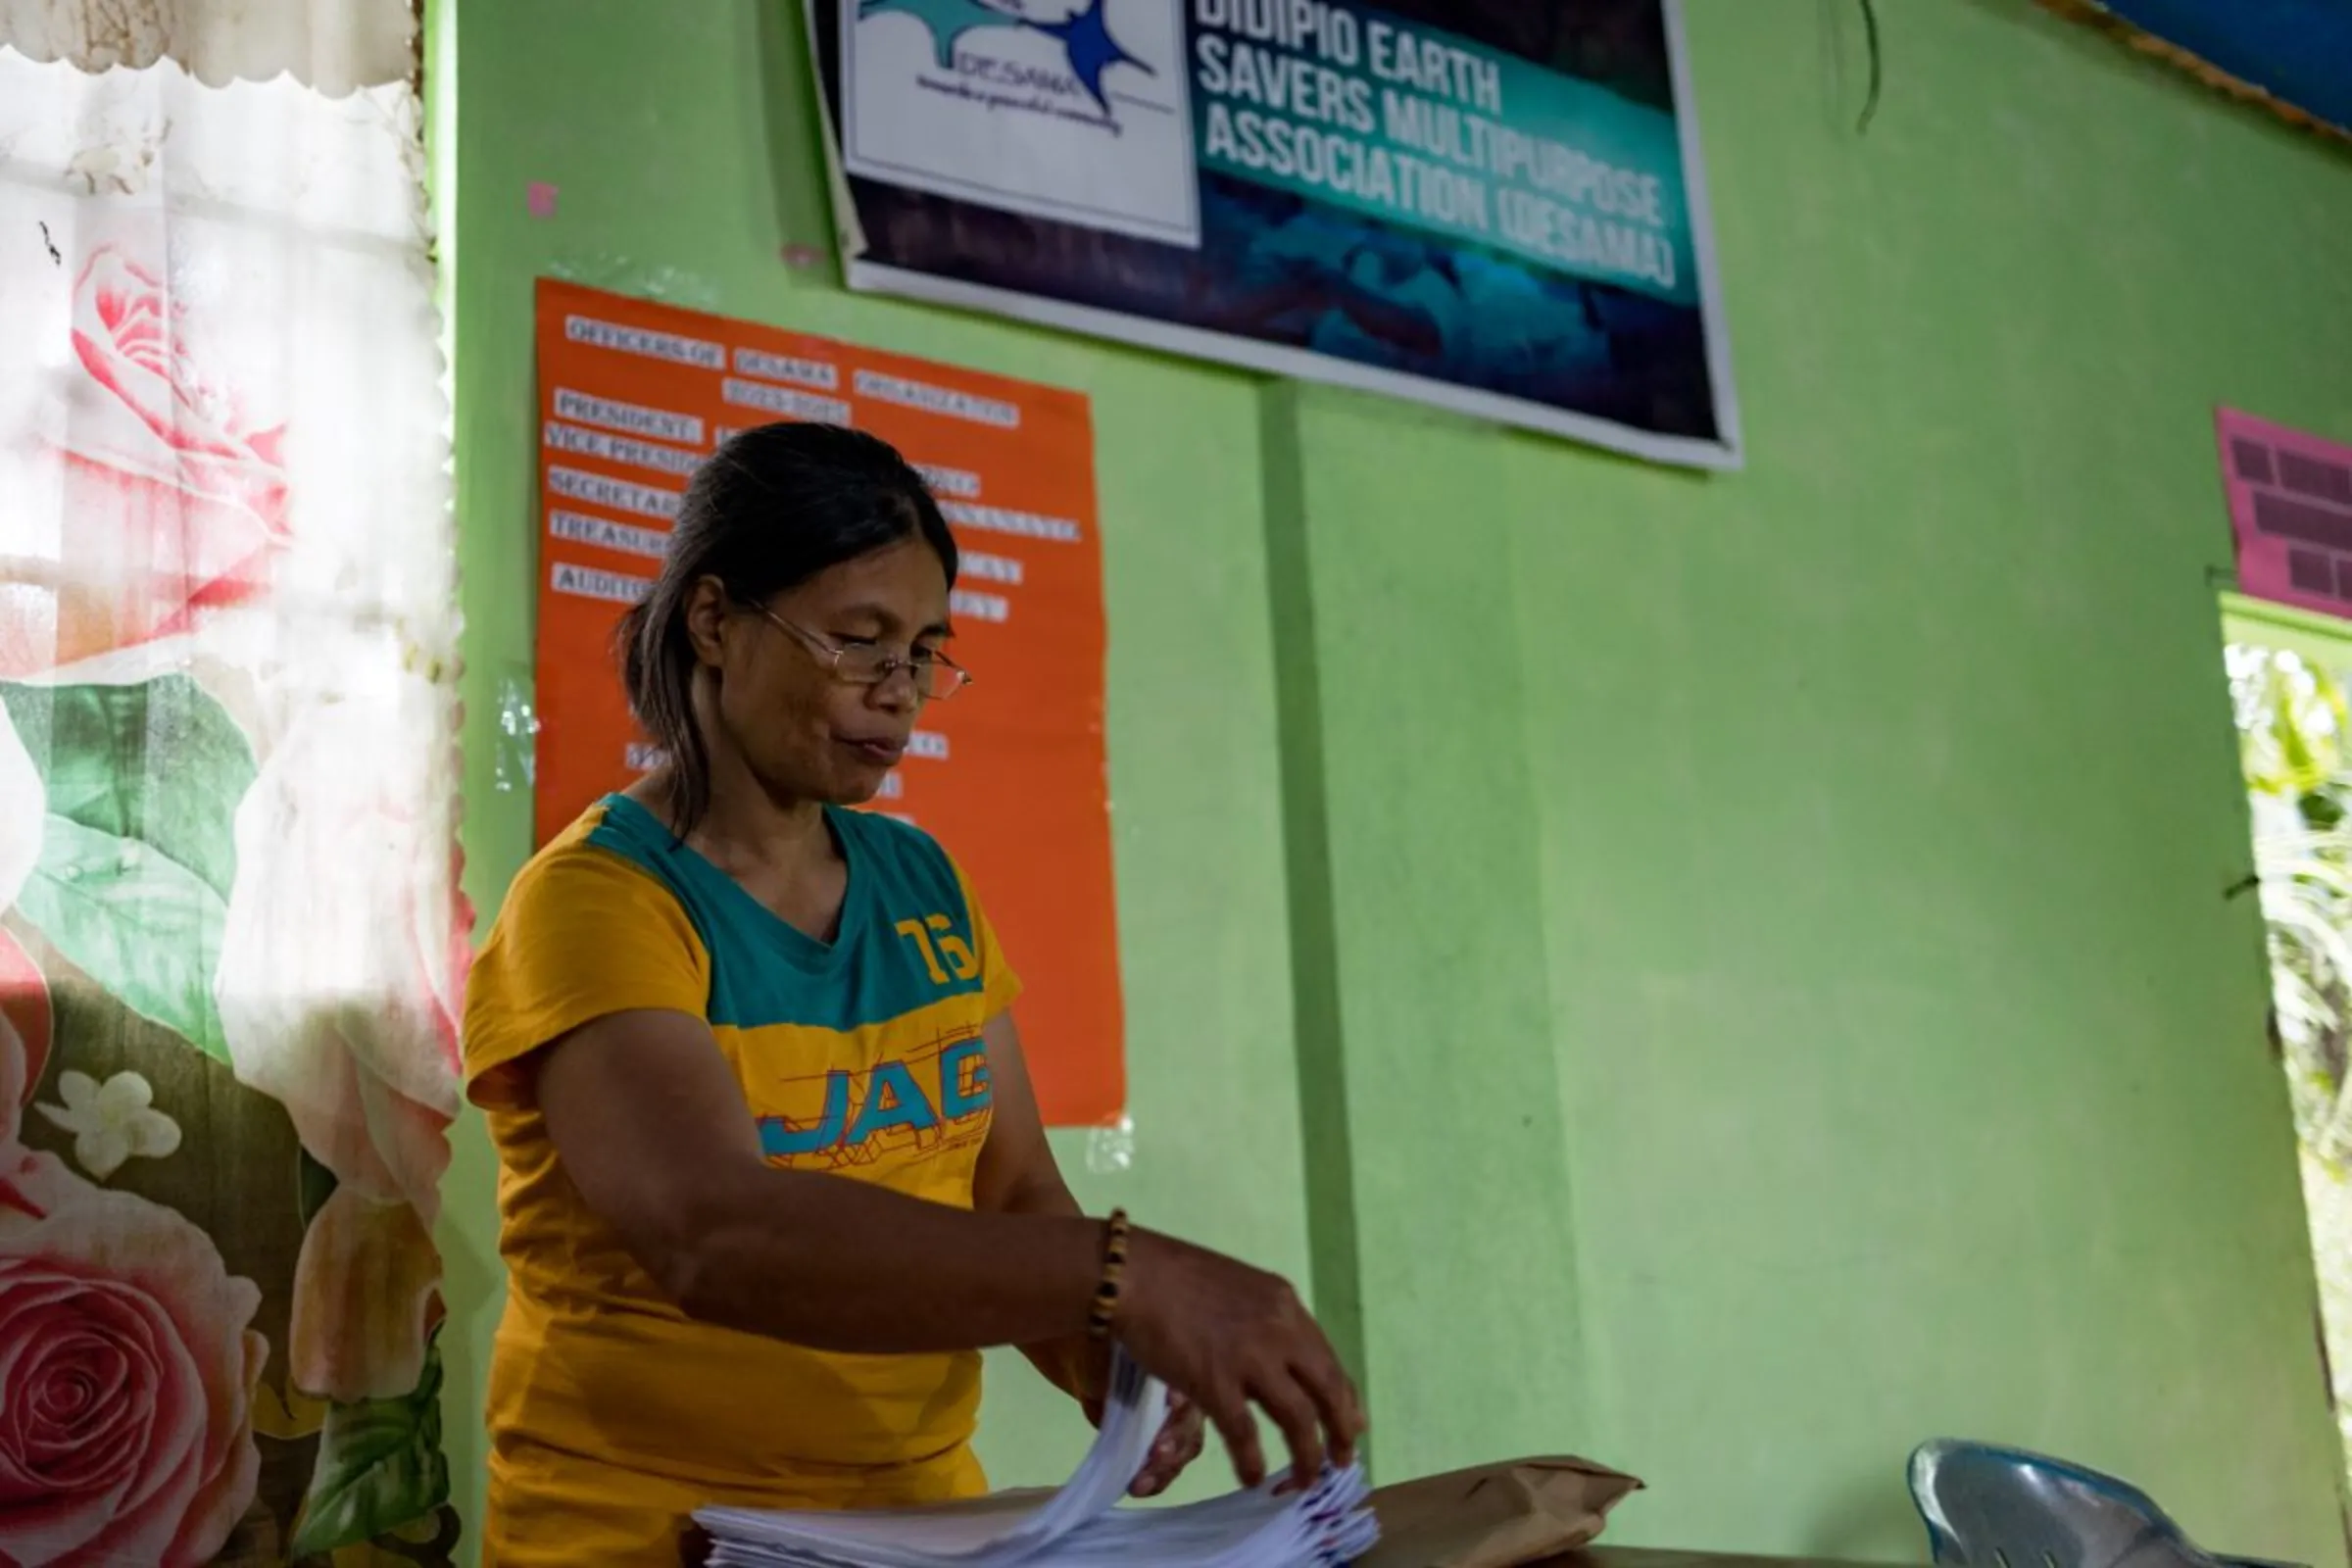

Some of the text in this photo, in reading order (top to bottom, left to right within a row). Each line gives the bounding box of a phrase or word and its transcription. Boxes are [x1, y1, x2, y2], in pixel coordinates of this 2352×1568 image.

[1196, 33, 1375, 132] SAVERS
[1382, 89, 1663, 227] MULTIPURPOSE
[1367, 20, 1501, 114] EARTH
[1206, 102, 1489, 230] ASSOCIATION
[1497, 187, 1676, 289] (DESAMA)
